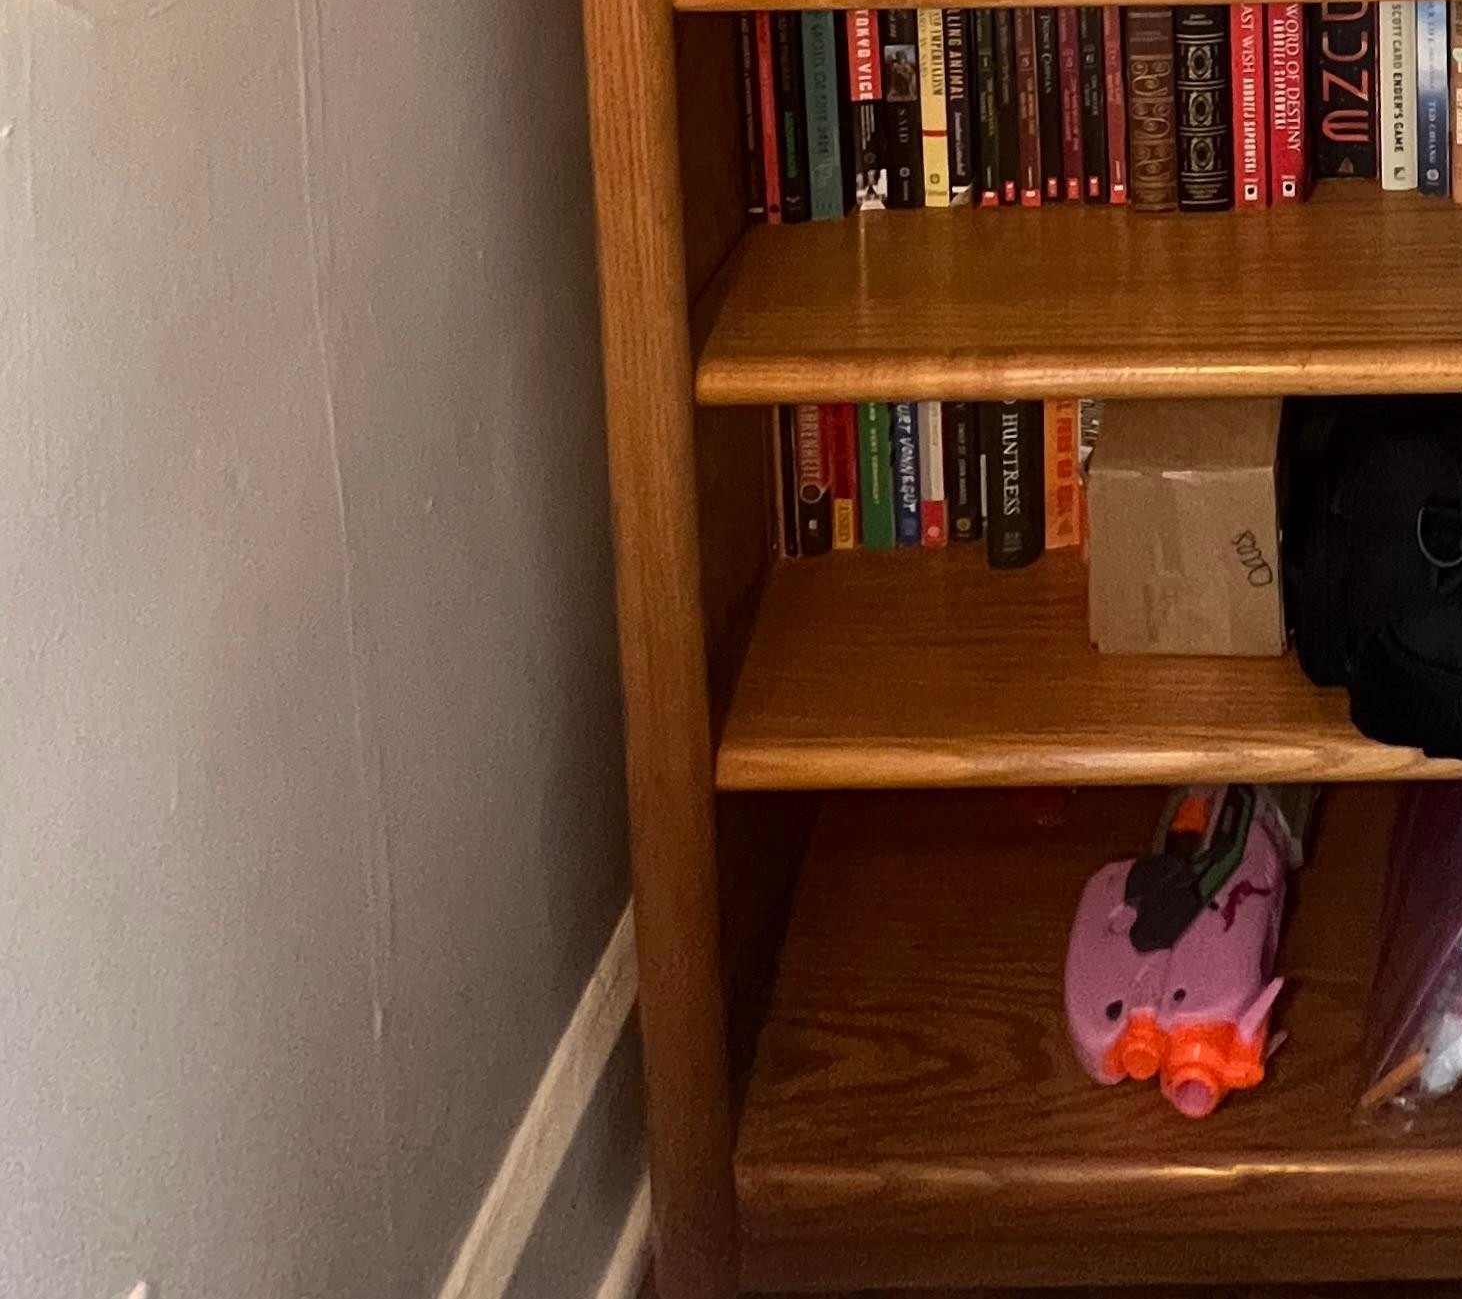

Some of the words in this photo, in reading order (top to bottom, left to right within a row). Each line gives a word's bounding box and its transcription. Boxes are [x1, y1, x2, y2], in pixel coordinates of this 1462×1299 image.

[854, 9, 872, 58] TOKYO
[858, 63, 874, 101] VICE
[1392, 72, 1404, 120] ENDER'S
[1394, 122, 1404, 153] GAME
[898, 436, 917, 514] VONNEGUT
[1001, 412, 1020, 516] HUNTRESS
